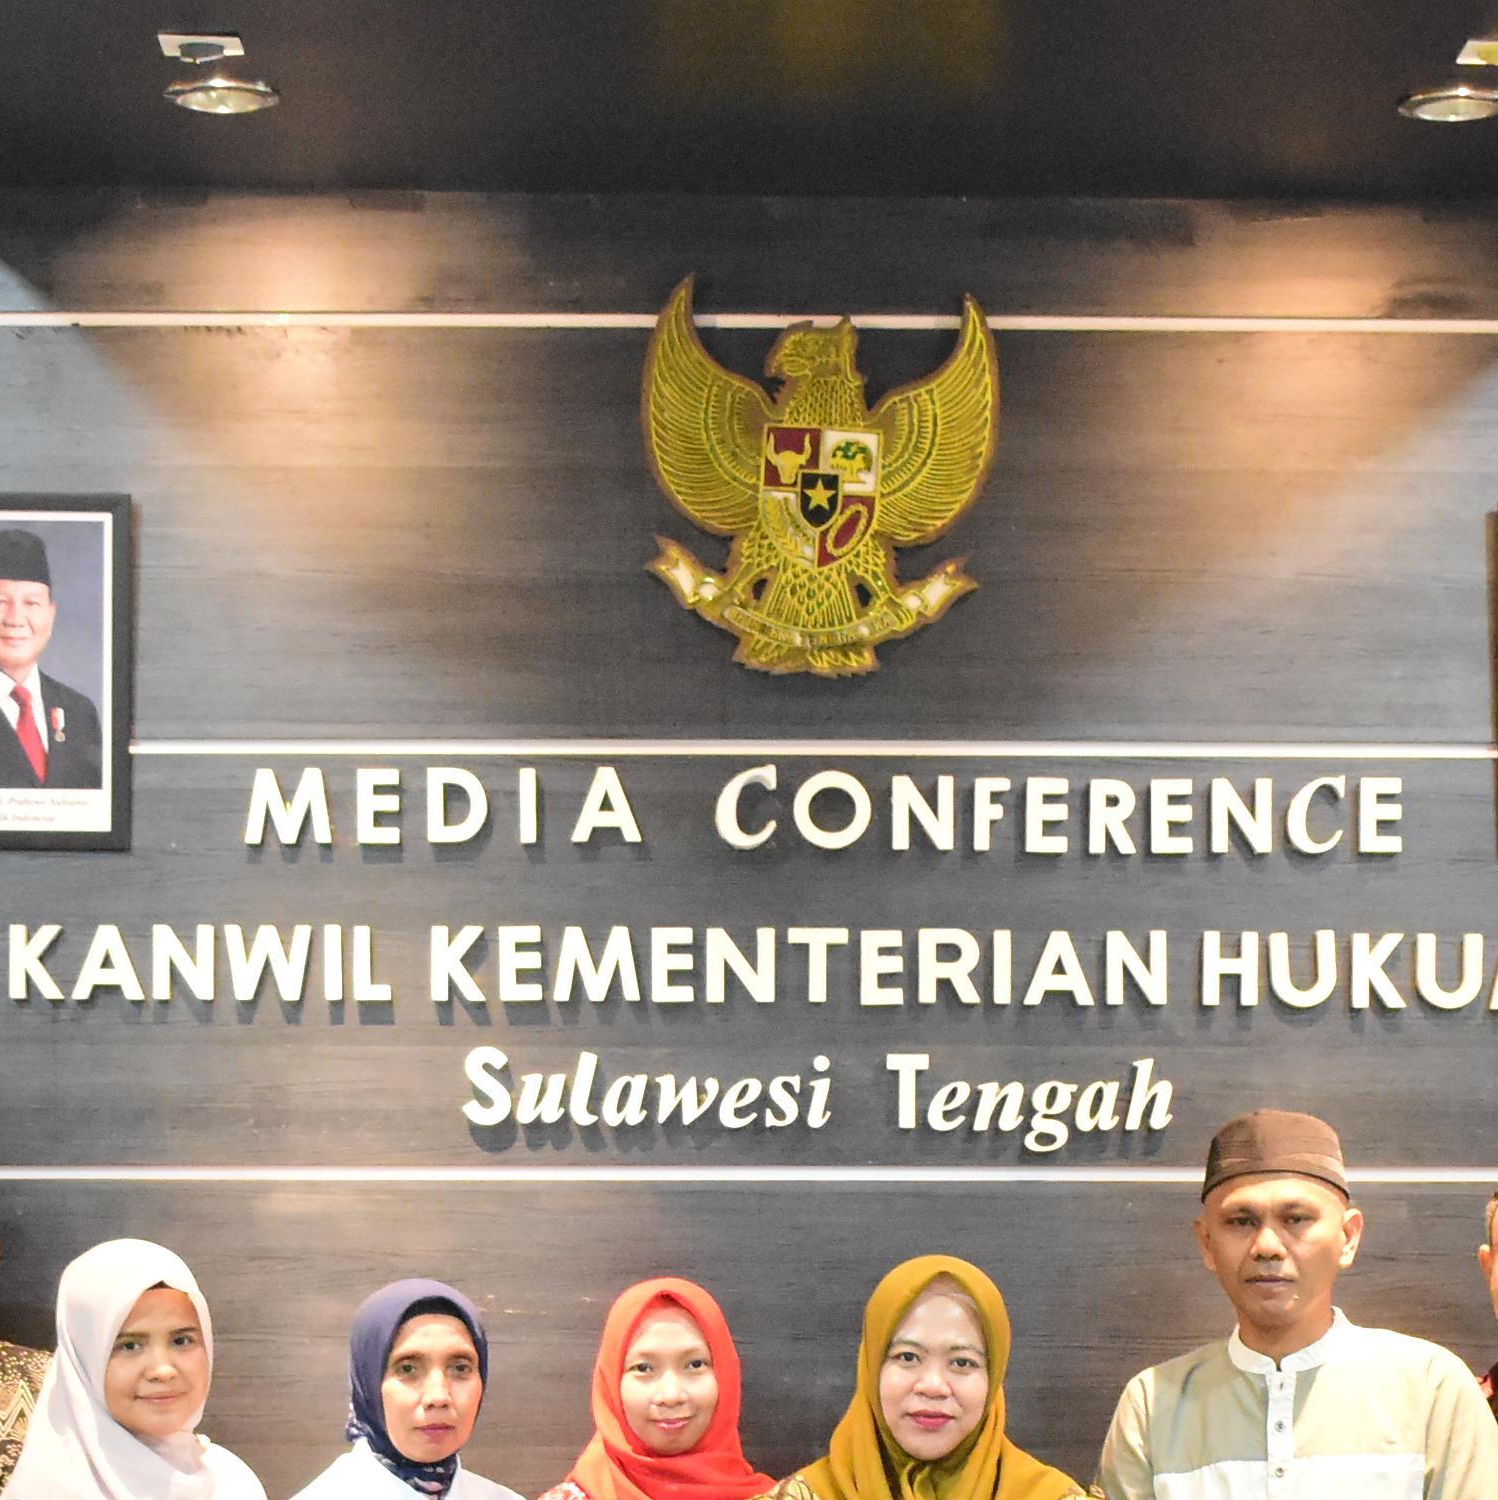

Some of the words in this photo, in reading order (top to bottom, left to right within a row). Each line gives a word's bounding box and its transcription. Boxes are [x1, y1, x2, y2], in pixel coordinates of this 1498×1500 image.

[243, 765, 642, 845] MEDIA
[714, 763, 1404, 856] CONFERENCE
[7, 922, 393, 1002] KANWIL
[428, 924, 1169, 1007] KEMENTERIAN
[461, 1044, 833, 1130] Sulawesi
[885, 1052, 1174, 1153] Tengah
